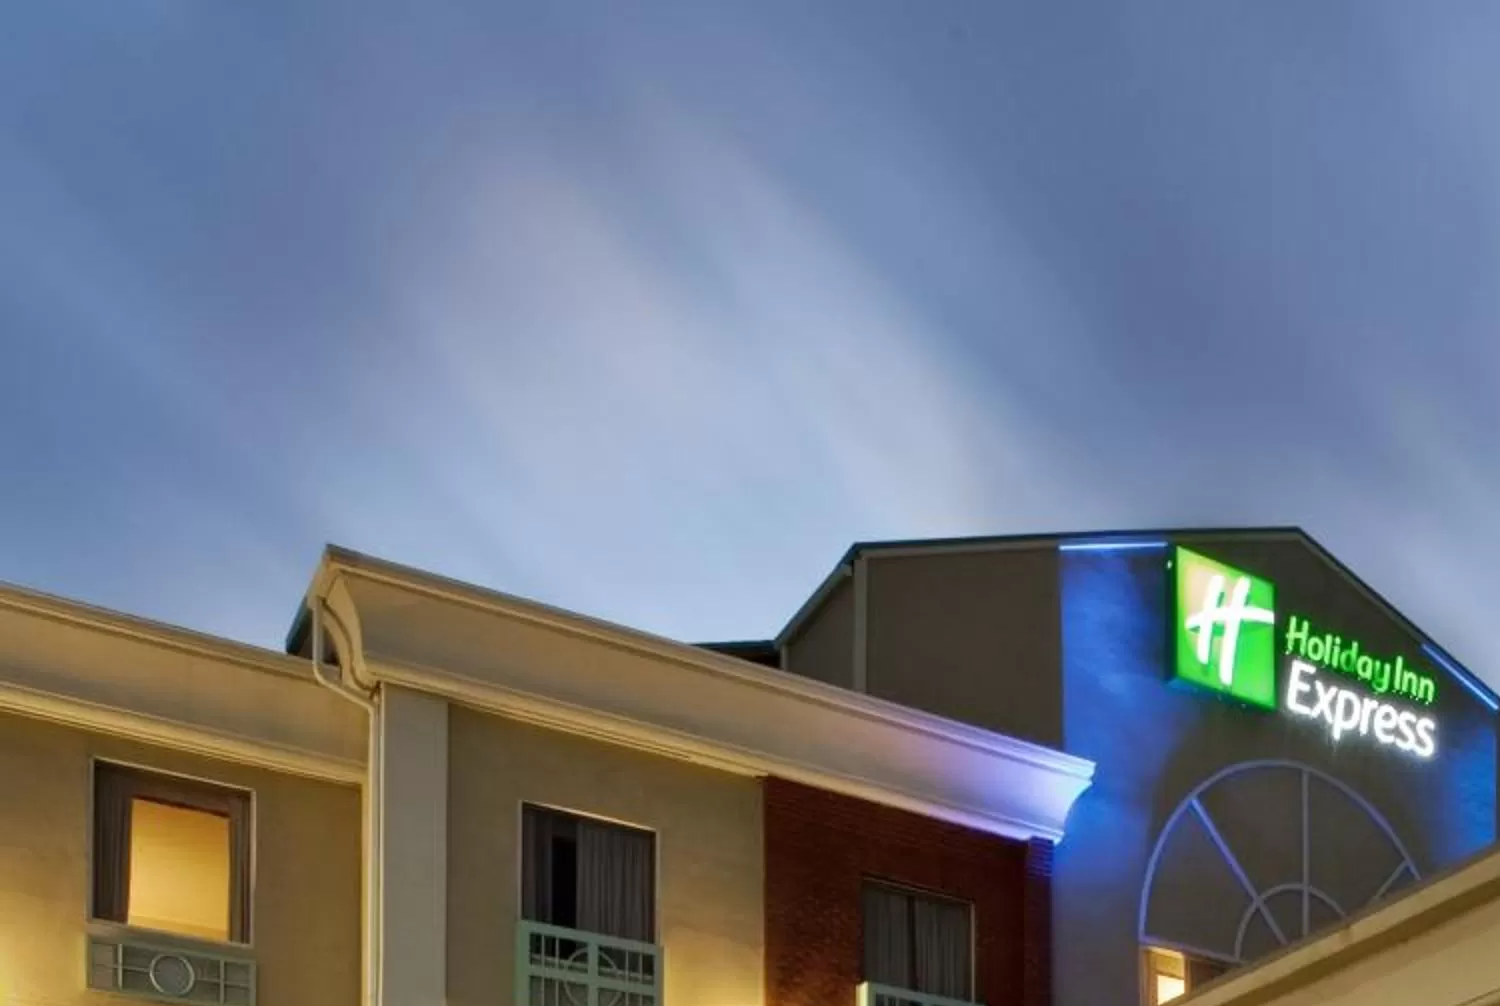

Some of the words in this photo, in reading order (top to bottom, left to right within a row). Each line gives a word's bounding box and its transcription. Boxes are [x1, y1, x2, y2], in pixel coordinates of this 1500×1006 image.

[1286, 615, 1391, 693] Holiday
[1394, 656, 1435, 703] Inn
[1286, 659, 1436, 757] Express
